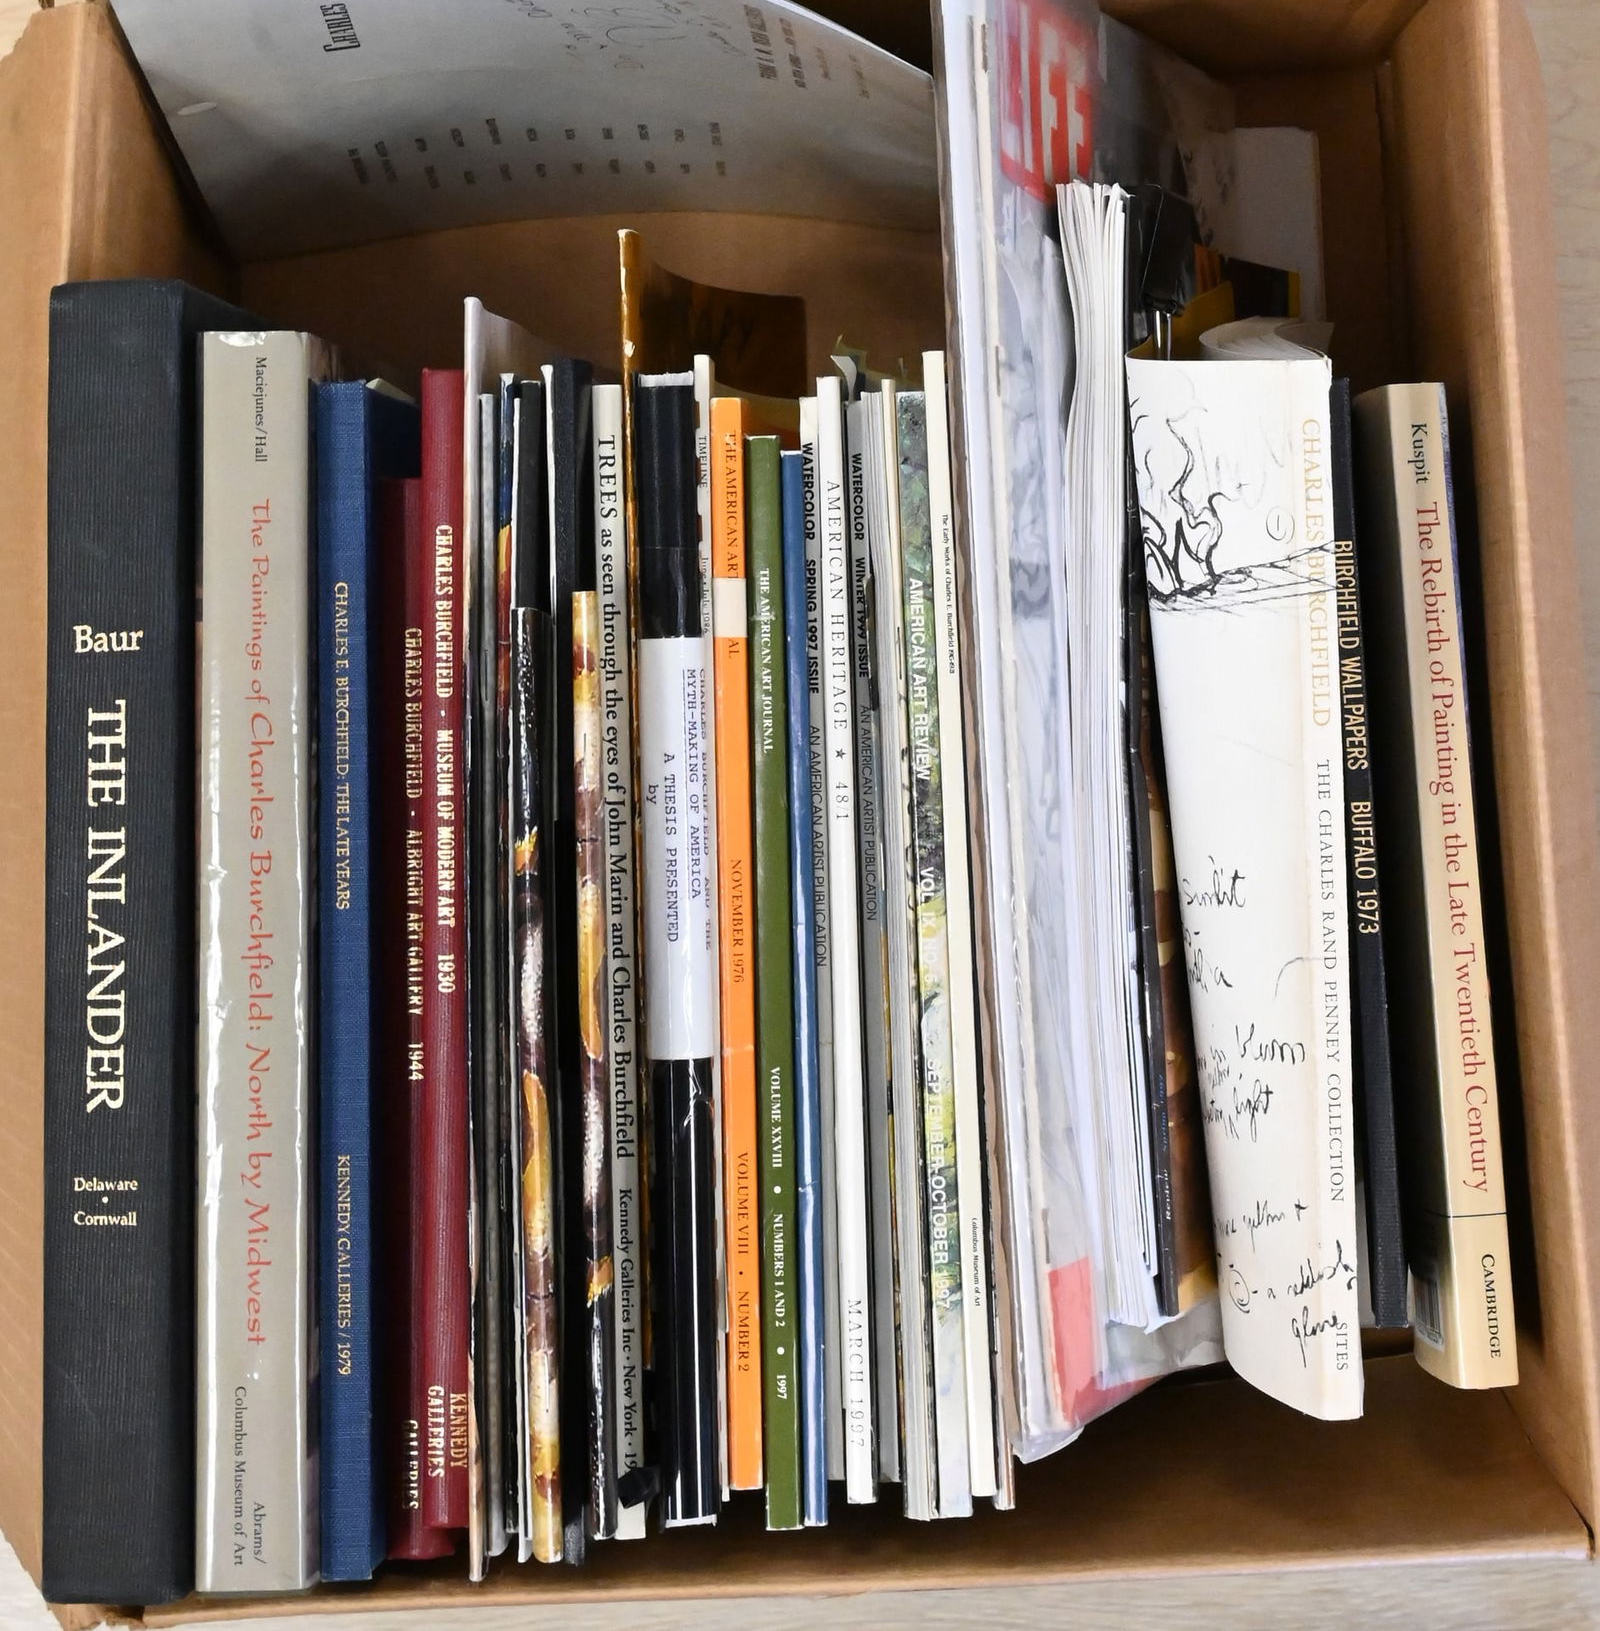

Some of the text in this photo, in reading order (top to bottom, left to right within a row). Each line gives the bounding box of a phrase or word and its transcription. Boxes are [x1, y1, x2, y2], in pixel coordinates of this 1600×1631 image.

[323, 3, 361, 52] CHARLES
[725, 466, 738, 548] AMERICAN
[802, 442, 818, 612] WATERCOLOR SPRING
[1407, 423, 1430, 484] Kuspit
[827, 481, 844, 601] AMERICAN
[1302, 418, 1331, 728] CHARLES BURCHFIELD
[73, 624, 144, 655] Baur
[831, 614, 848, 730] HERITAGE
[851, 453, 878, 921] WATERCOLOR PUBLICATION
[909, 577, 931, 782] AMERICAN ART REVIEW
[334, 581, 351, 911] CHARLES BURCHFIELD: THE LATE YEARS
[435, 524, 456, 994] CHARLES BURCHFIELD MUSEUM MODERN ART 1930
[597, 434, 636, 1160] TREES seen through the John Marin and Charles Burchfield
[762, 694, 774, 753] JOURNAL
[1334, 540, 1380, 934] BURCHFIELD WALLPAPERS BUFFALO 1973
[85, 699, 127, 1114] THE INLANDER
[240, 497, 275, 1345] The Paintings of Charles Burchfield: North by Midwest
[404, 627, 425, 1082] CHARLES BURCHFIELD ALBRIGHT 1944
[664, 774, 679, 942] THESIS PRESENTED
[690, 825, 701, 899] AMERICA
[730, 859, 743, 948] NOVEMBER
[1415, 501, 1489, 1194] The Rebirth of Painting in the Late Twentieth Century
[1316, 758, 1345, 1202] THE CHARLES RAND PENNEY COLLECTION
[73, 1177, 138, 1192] Delaware
[73, 1211, 138, 1227] Cornwall
[737, 1151, 750, 1360] VOLUME NUMBER
[770, 1067, 788, 1399] VOLUME NUMBERS 1997
[337, 1154, 352, 1376] KENNEDY GALLERIES 1979
[617, 1188, 638, 1445] Kennedy Galleries New York
[1480, 1252, 1502, 1359] CAMBRIDGE
[848, 1299, 865, 1448] MARCH 1997
[1335, 1321, 1349, 1371] SITES
[233, 1385, 248, 1519] Columbus Museum
[427, 1384, 446, 1478] GALLERIES
[450, 1392, 468, 1469] KENNEDY
[253, 1501, 268, 1565] Abrams/
